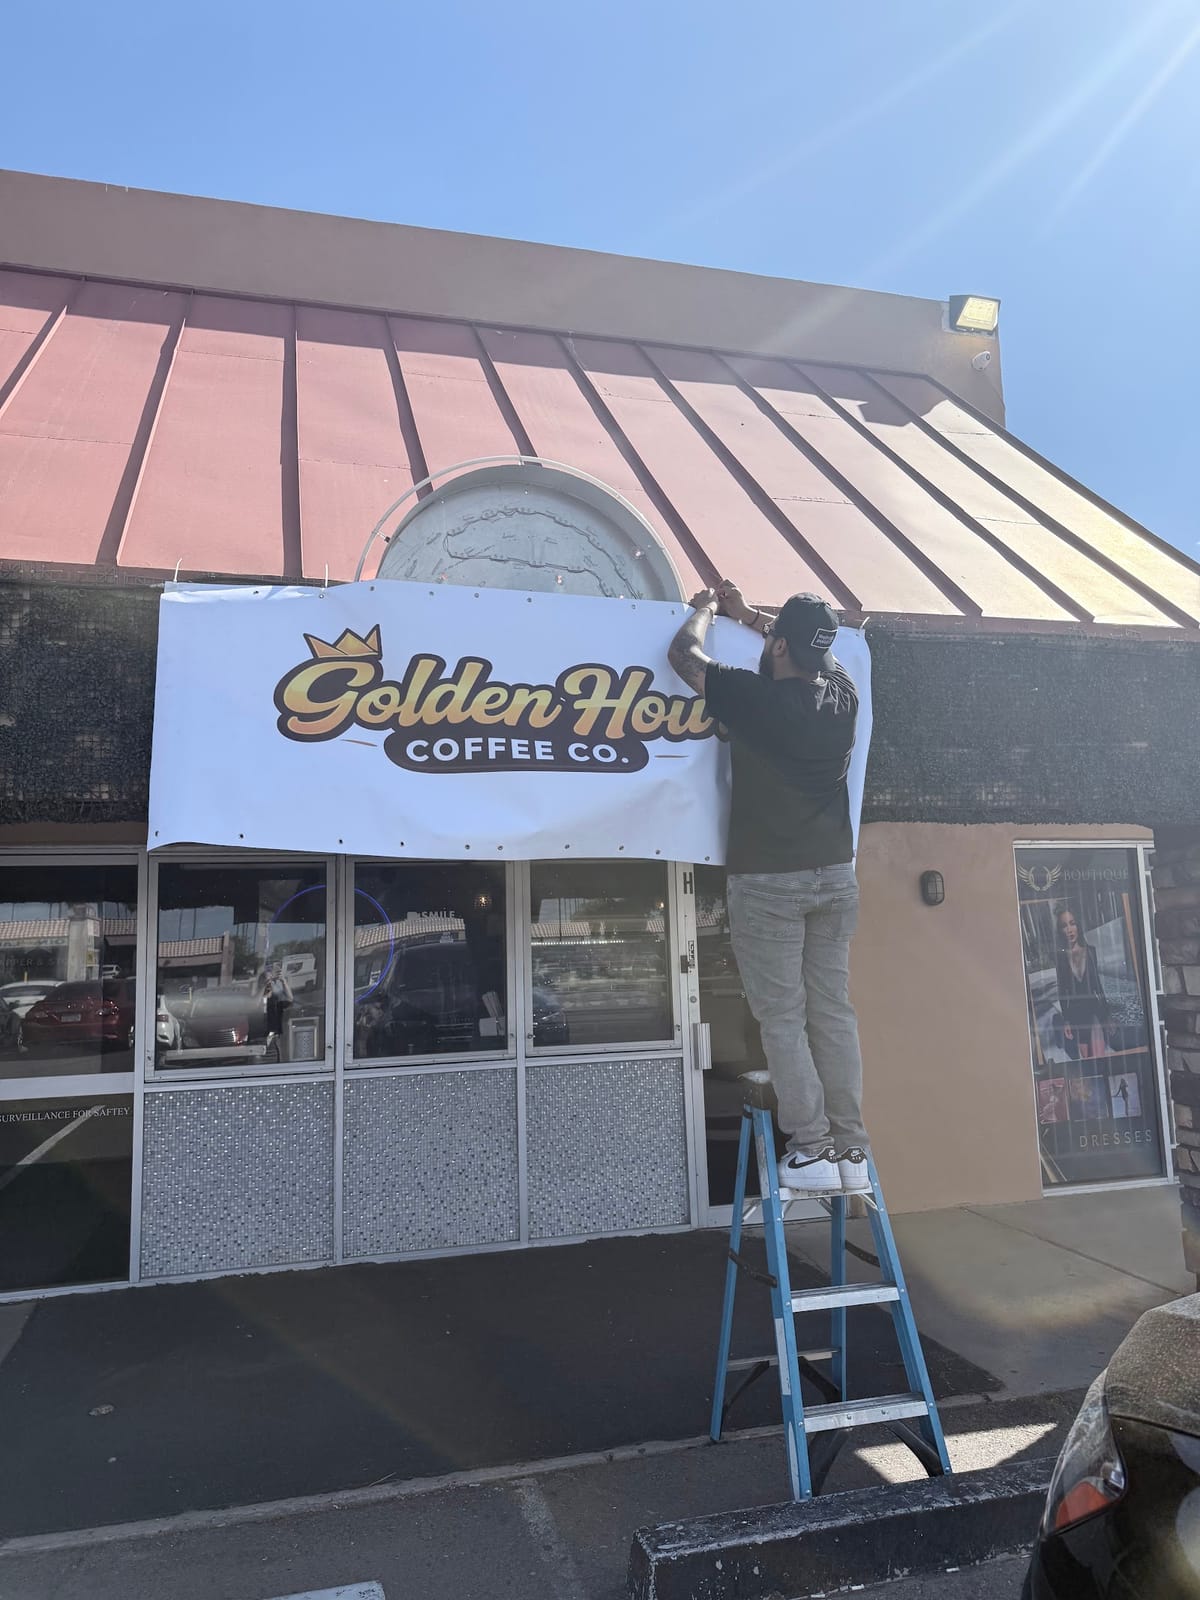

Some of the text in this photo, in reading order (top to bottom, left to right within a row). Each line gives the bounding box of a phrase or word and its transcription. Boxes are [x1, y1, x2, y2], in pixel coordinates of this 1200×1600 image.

[282, 658, 729, 740] Golden Hou
[405, 736, 630, 765] COFFEE CO.
[94, 1106, 130, 1117] SAFTEY
[1079, 1128, 1152, 1148] DRESSES
